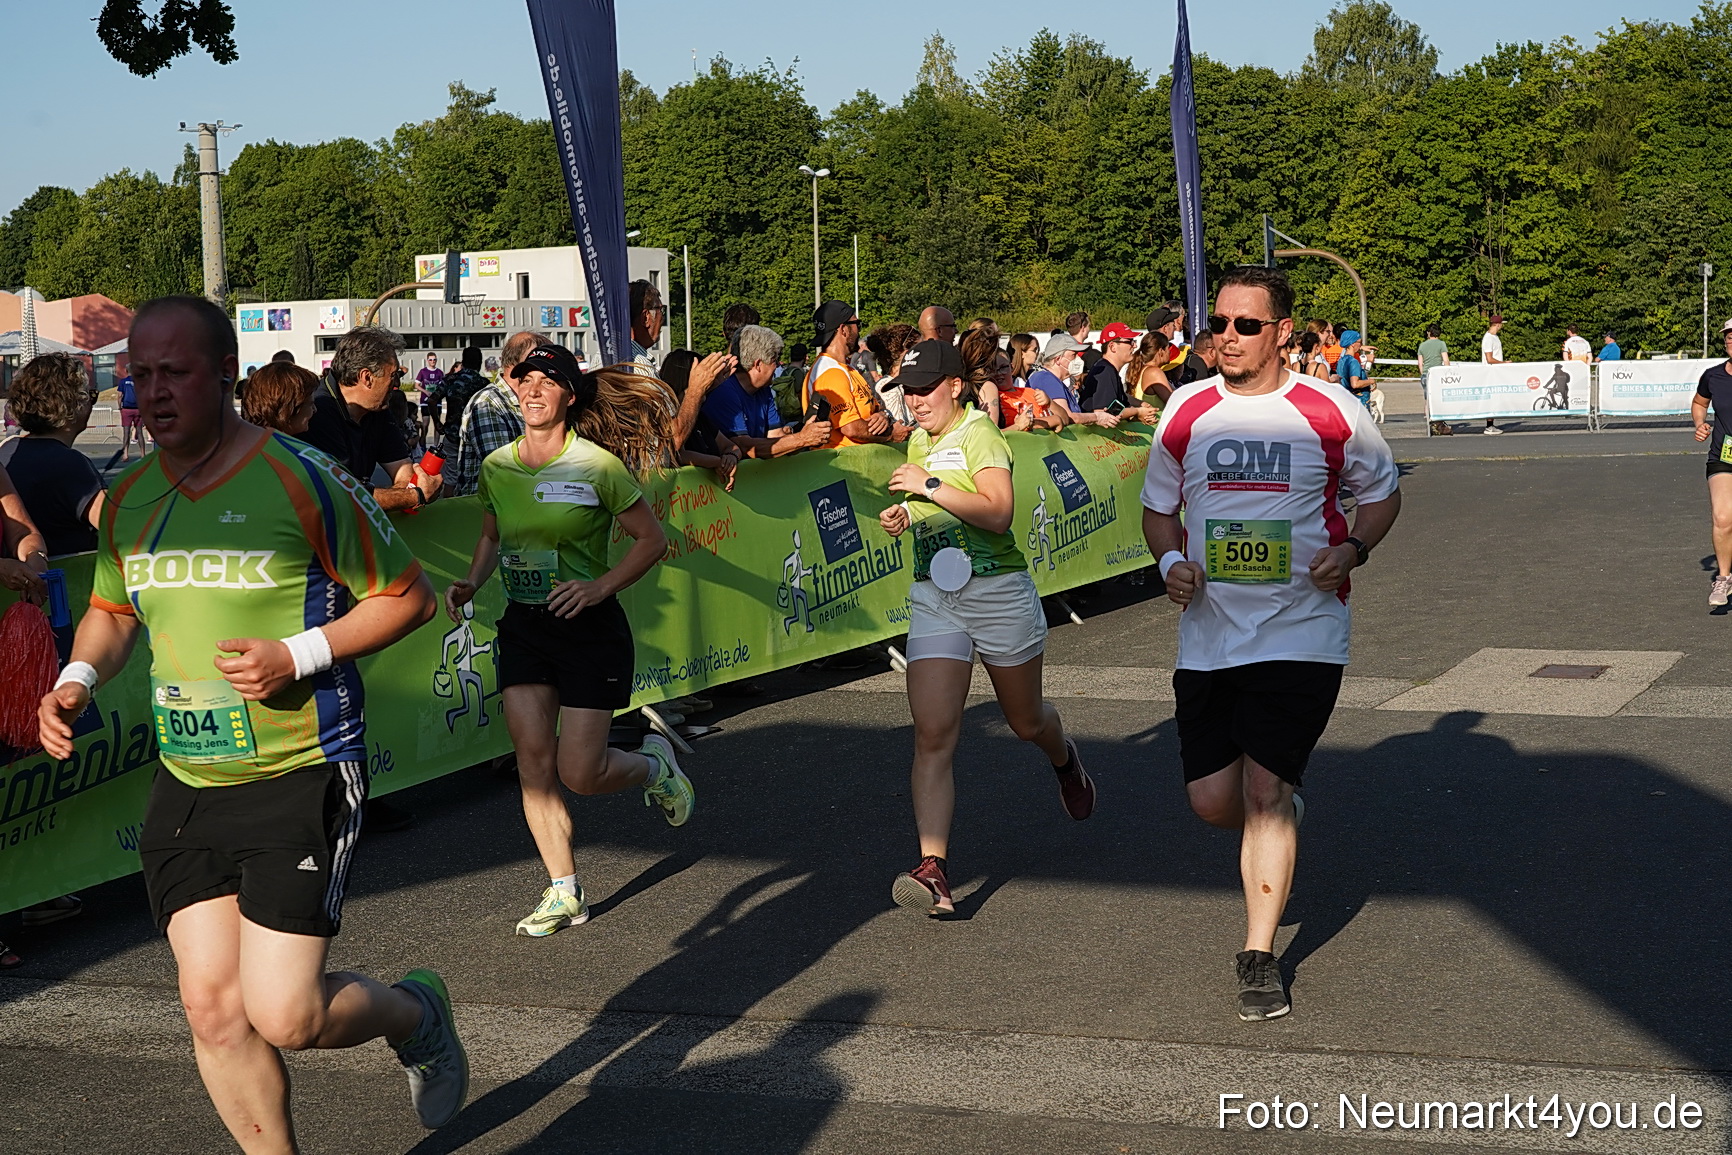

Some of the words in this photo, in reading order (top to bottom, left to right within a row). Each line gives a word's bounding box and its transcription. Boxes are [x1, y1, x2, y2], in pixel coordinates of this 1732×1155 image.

[1441, 376, 1461, 384] NOW
[1443, 388, 1473, 396] E-BIKES
[1206, 439, 1291, 472] OM
[1055, 468, 1075, 484] Fischer
[298, 447, 397, 547] BOCK
[668, 484, 718, 518] Firmen
[822, 506, 848, 525] Fischer
[828, 518, 849, 532] AUTOMOBILE
[1054, 485, 1117, 549] firmenlauf
[683, 506, 737, 556] länger!
[1058, 538, 1089, 565] neumarkt
[1210, 543, 1218, 573] WALK
[1225, 541, 1269, 562] 509
[1279, 545, 1287, 574] 2022
[125, 549, 279, 592] BOCK
[512, 570, 543, 587] 939
[549, 572, 558, 590] 022
[812, 535, 904, 605] firmenlauf
[1243, 564, 1272, 572] Sascha
[819, 593, 860, 625] neumarkt
[157, 715, 168, 744] RUN
[169, 709, 220, 737] 604
[229, 710, 248, 749] 2022
[170, 737, 202, 750] Hessing
[204, 739, 229, 748] Jens
